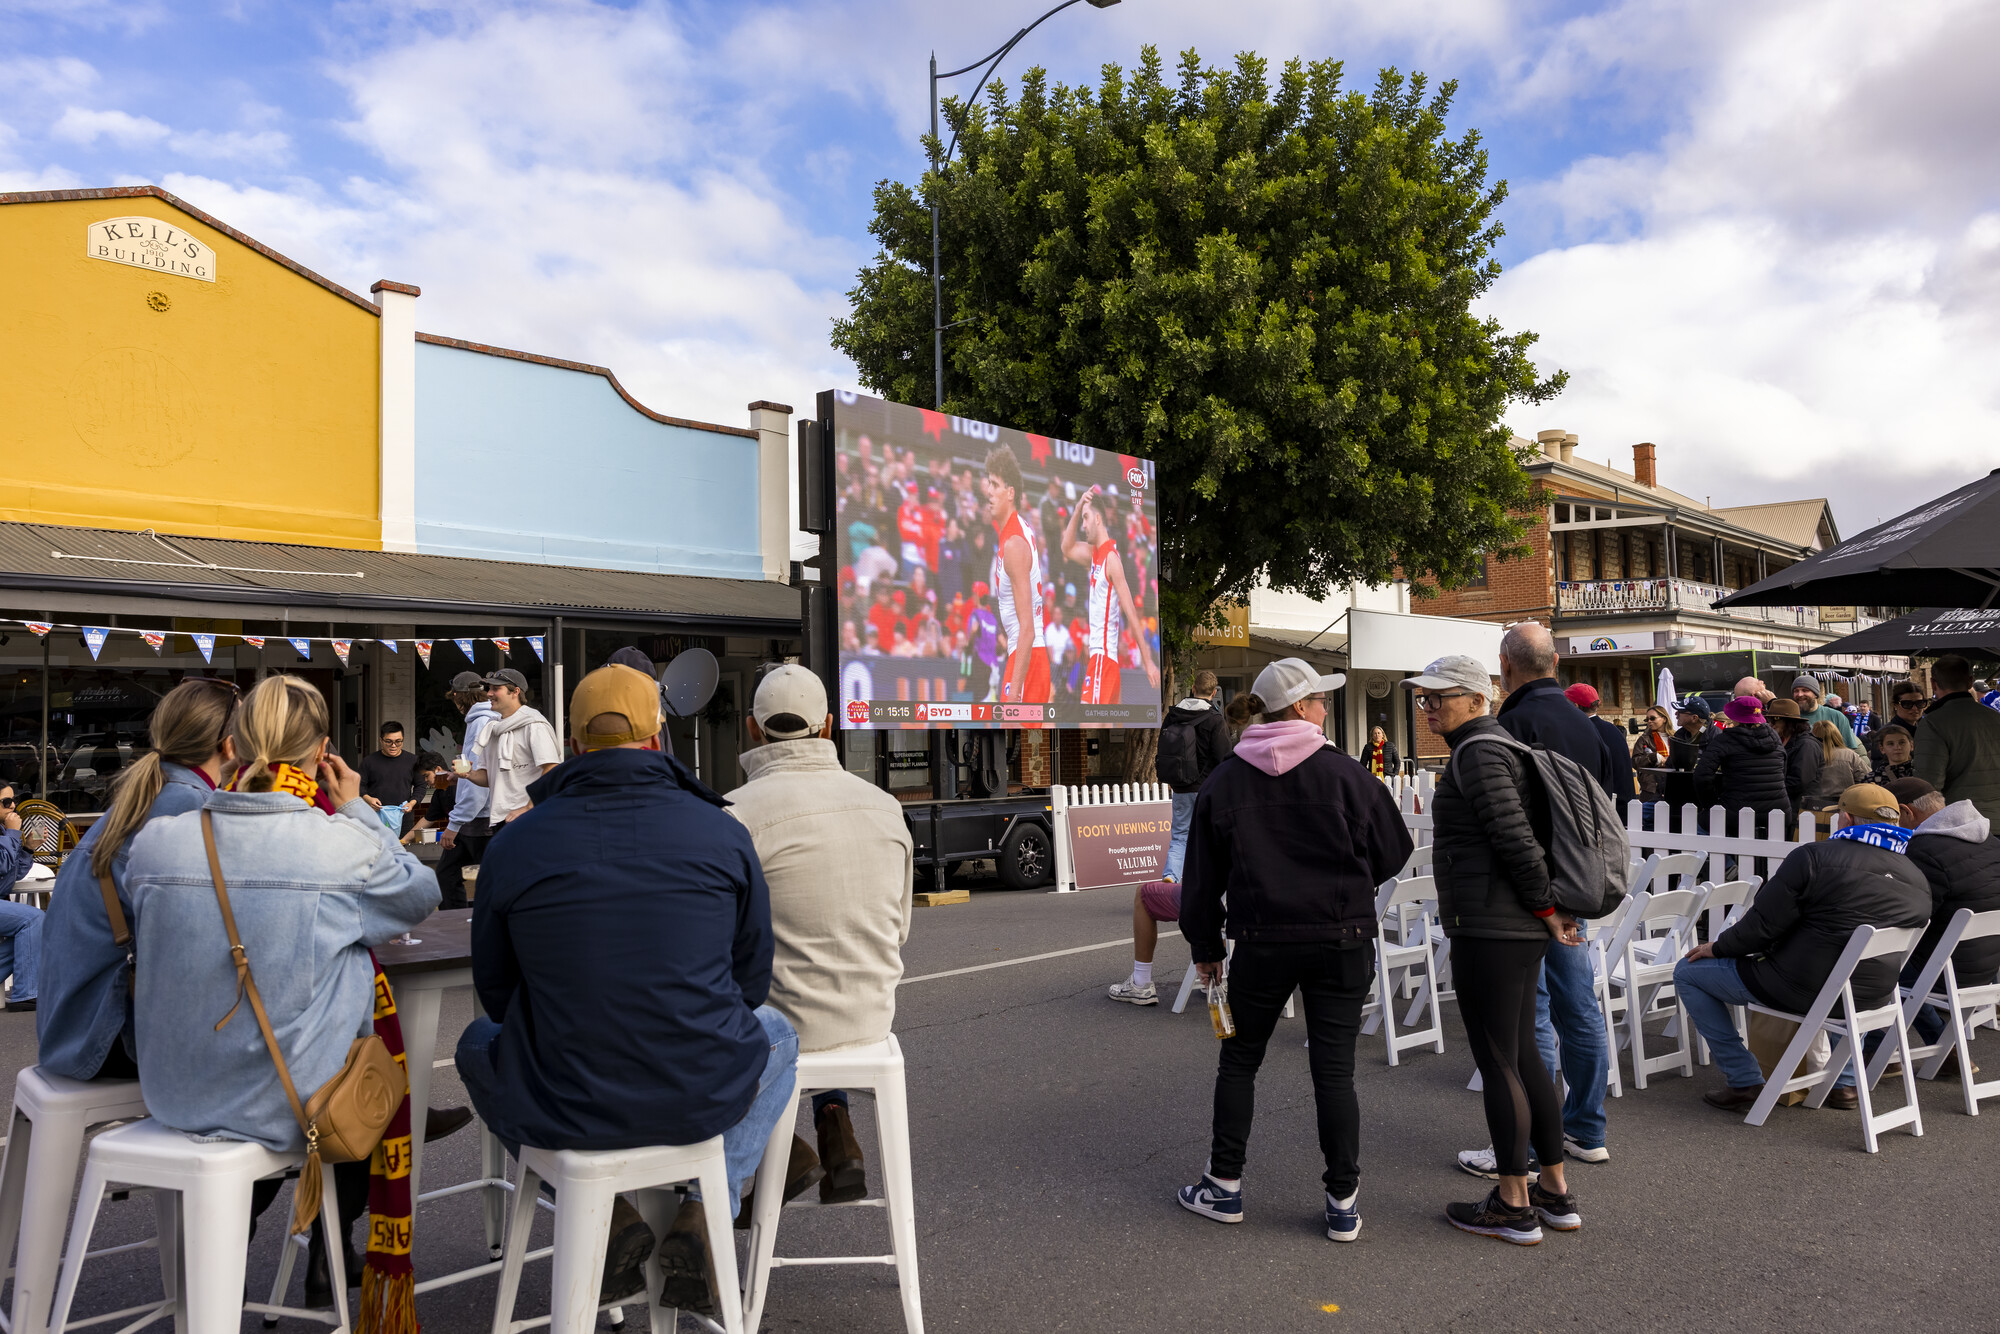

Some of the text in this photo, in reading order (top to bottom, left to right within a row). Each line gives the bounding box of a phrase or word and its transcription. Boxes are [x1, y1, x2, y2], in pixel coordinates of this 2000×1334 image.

[103, 222, 200, 259] KEIL'S
[146, 249, 164, 258] 1910
[98, 245, 206, 277] BUILDING
[1130, 472, 1143, 485] FOX
[874, 707, 883, 716] Q1
[887, 707, 910, 717] 15:15
[930, 709, 952, 717] SYD
[978, 707, 985, 718] 7
[1005, 709, 1020, 717] GC
[1048, 708, 1056, 718] 0
[1077, 820, 1172, 838] FOOTY VIEWING ZO
[1108, 846, 1128, 855] Proudly
[1129, 844, 1154, 853] sponsored
[1117, 856, 1158, 870] YALUMBA
